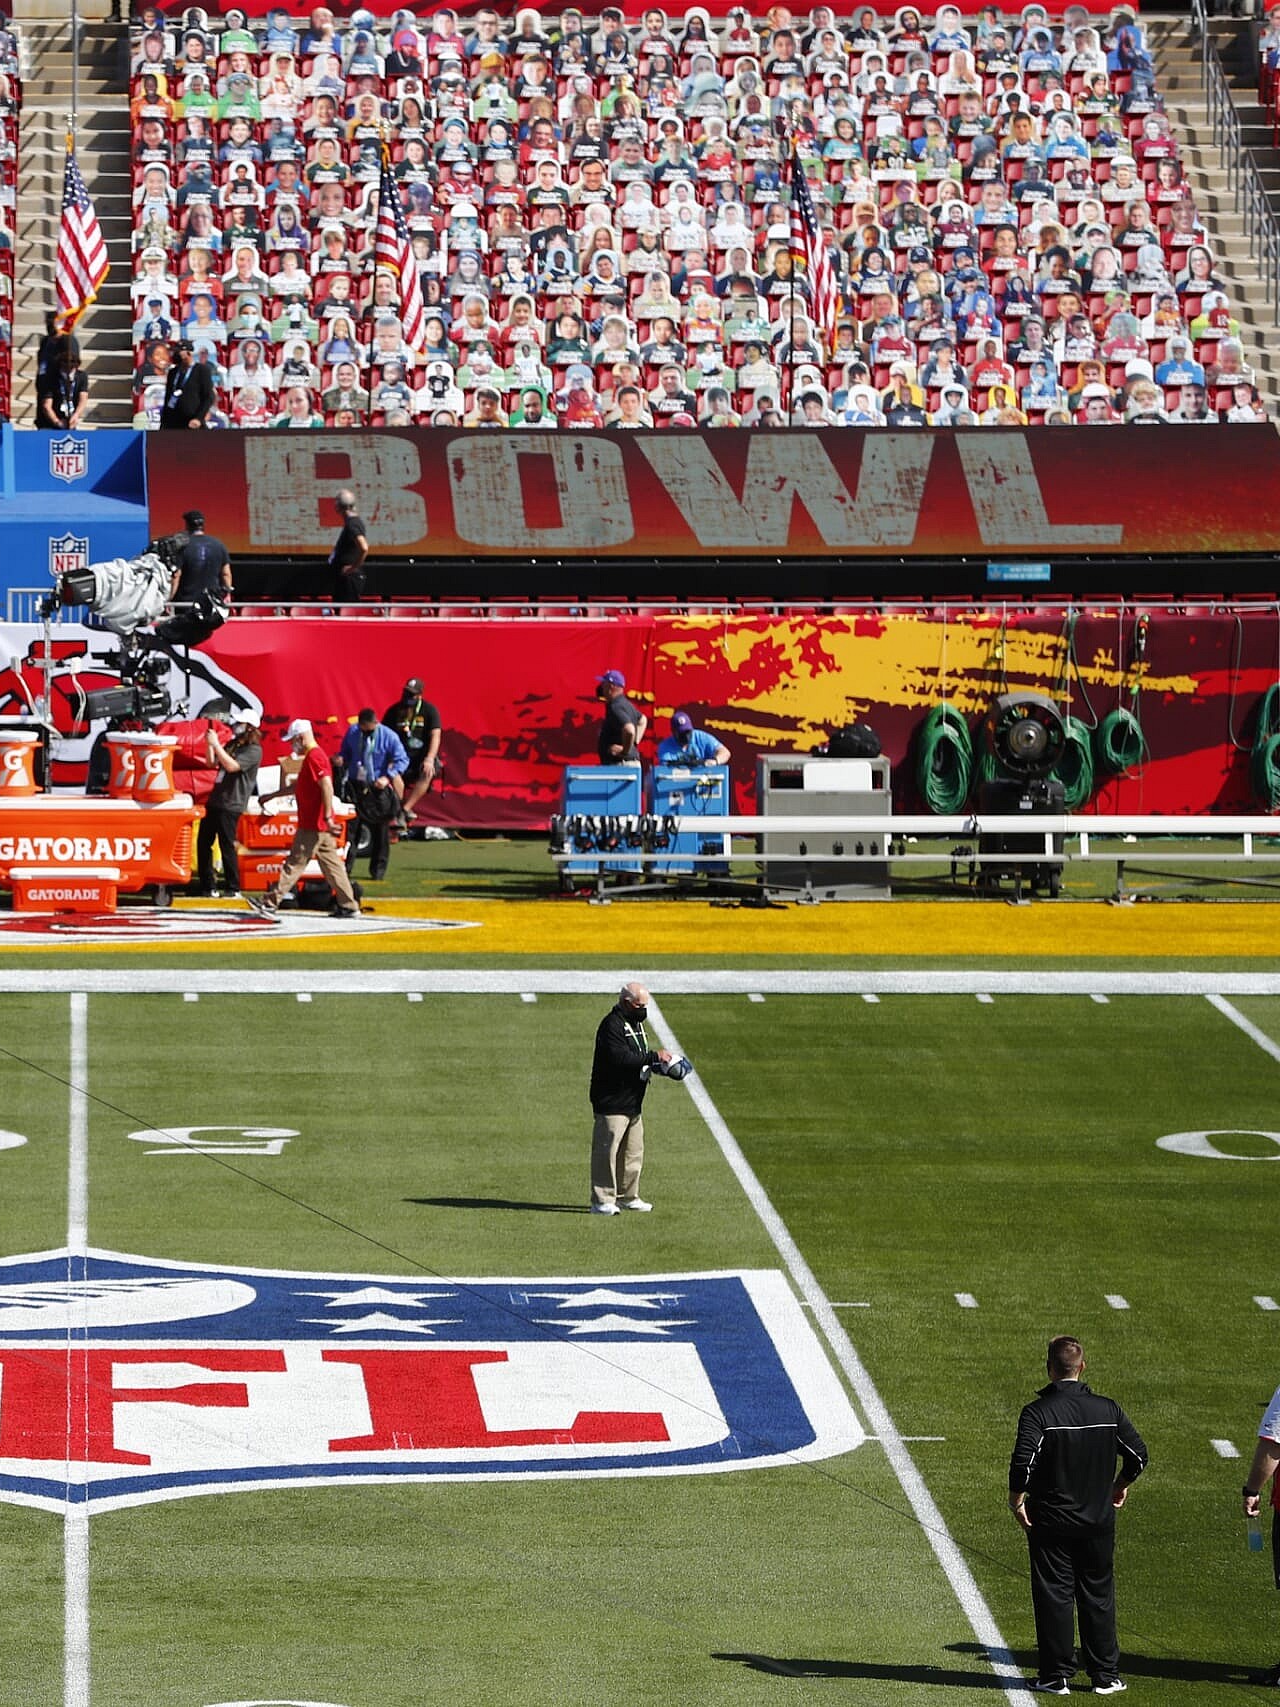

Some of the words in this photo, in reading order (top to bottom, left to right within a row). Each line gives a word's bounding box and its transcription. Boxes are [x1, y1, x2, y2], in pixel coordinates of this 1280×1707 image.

[55, 456, 82, 475] NFL
[245, 433, 1124, 548] BOWL
[4, 752, 23, 770] G
[145, 754, 164, 773] G
[27, 889, 100, 900] GATORADE
